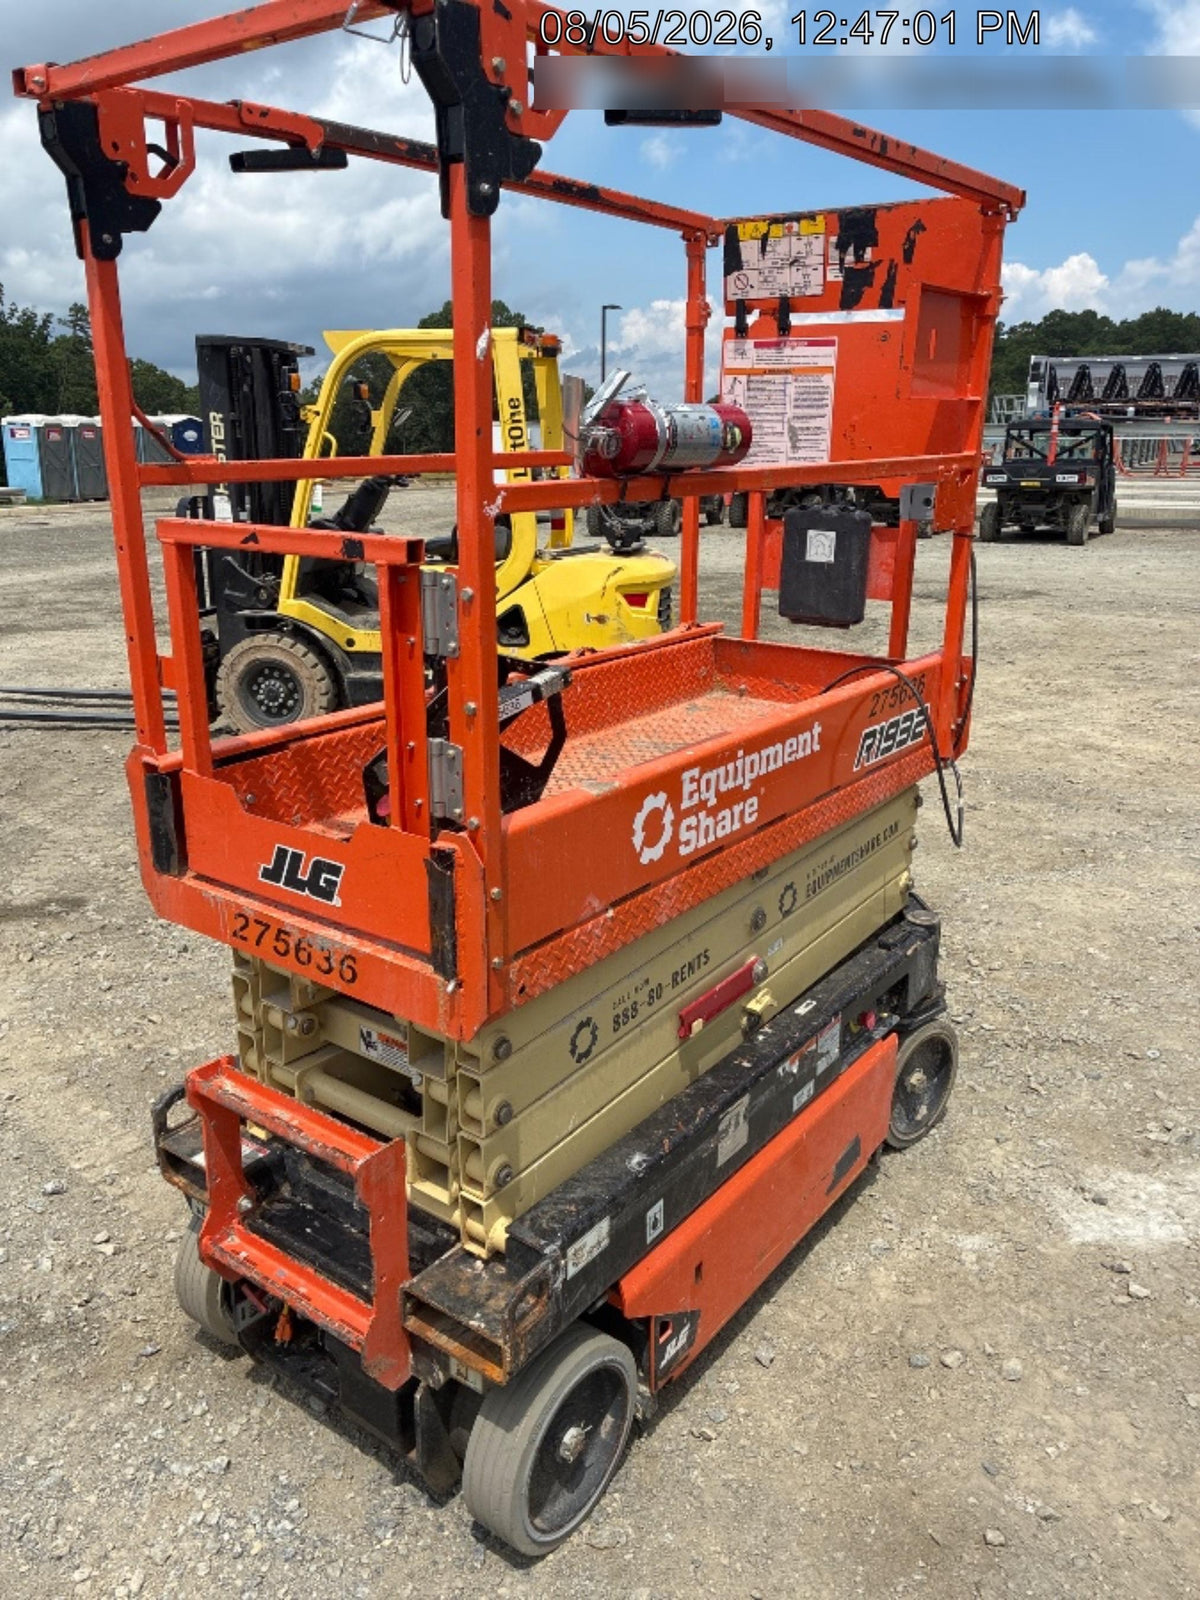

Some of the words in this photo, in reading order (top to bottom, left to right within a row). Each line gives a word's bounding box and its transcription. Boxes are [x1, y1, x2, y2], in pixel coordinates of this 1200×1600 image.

[680, 721, 822, 809] Equipment
[678, 795, 758, 856] Share
[259, 844, 345, 905] JLG
[232, 912, 358, 984] 275636
[612, 948, 711, 1033] 888-80-RENTS
[659, 1323, 691, 1369] JLG
